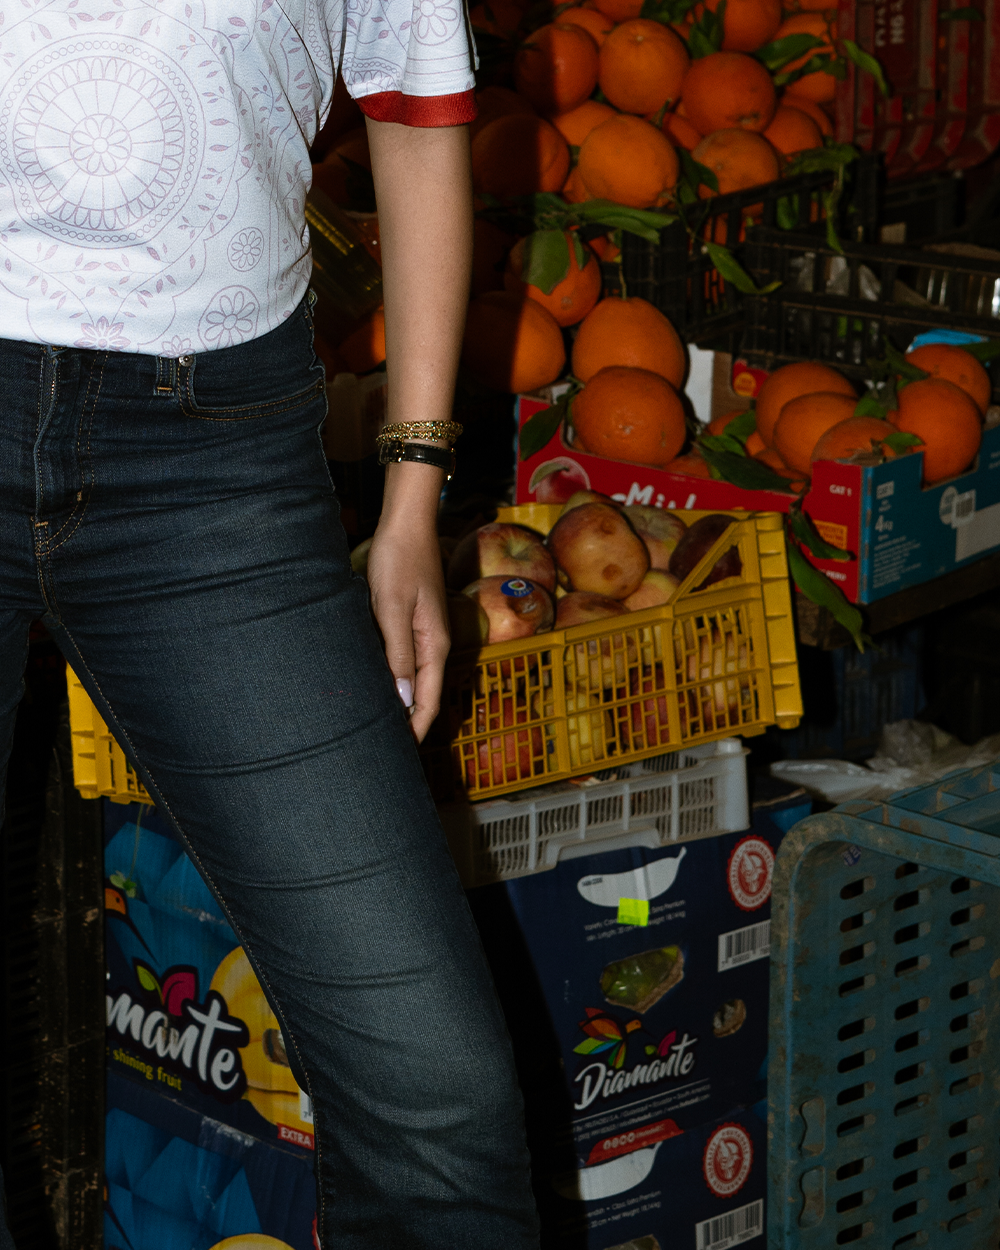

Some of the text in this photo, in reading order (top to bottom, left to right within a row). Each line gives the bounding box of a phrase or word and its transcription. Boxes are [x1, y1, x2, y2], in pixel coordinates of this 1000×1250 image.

[112, 1047, 182, 1091] shining fruit
[574, 1032, 698, 1111] Diamante
[280, 1126, 312, 1147] EXTRA
